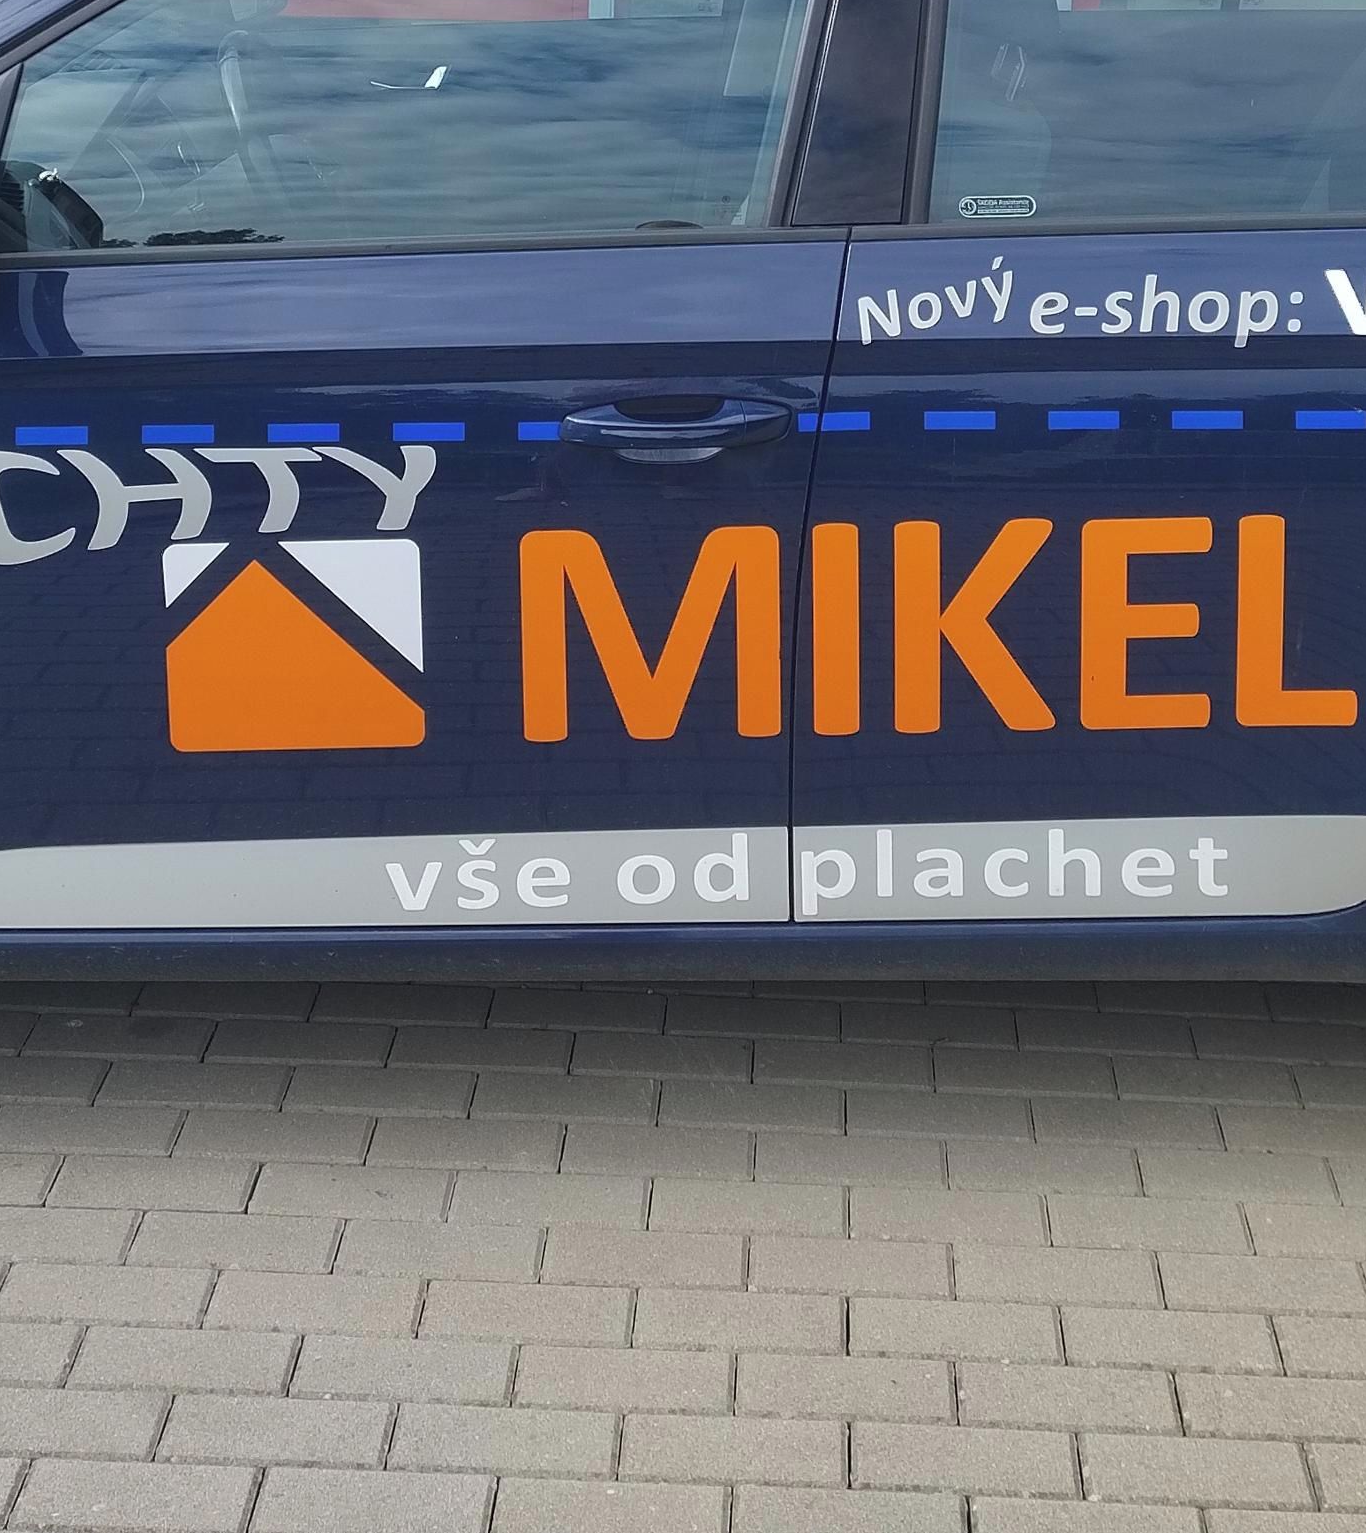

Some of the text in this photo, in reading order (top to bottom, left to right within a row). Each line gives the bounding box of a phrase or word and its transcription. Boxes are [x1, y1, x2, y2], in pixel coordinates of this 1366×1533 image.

[856, 254, 1014, 346] Nový
[1028, 273, 1304, 348] e-shop:
[518, 514, 1358, 743] MIKEL
[384, 828, 1229, 917] vše od plachet
